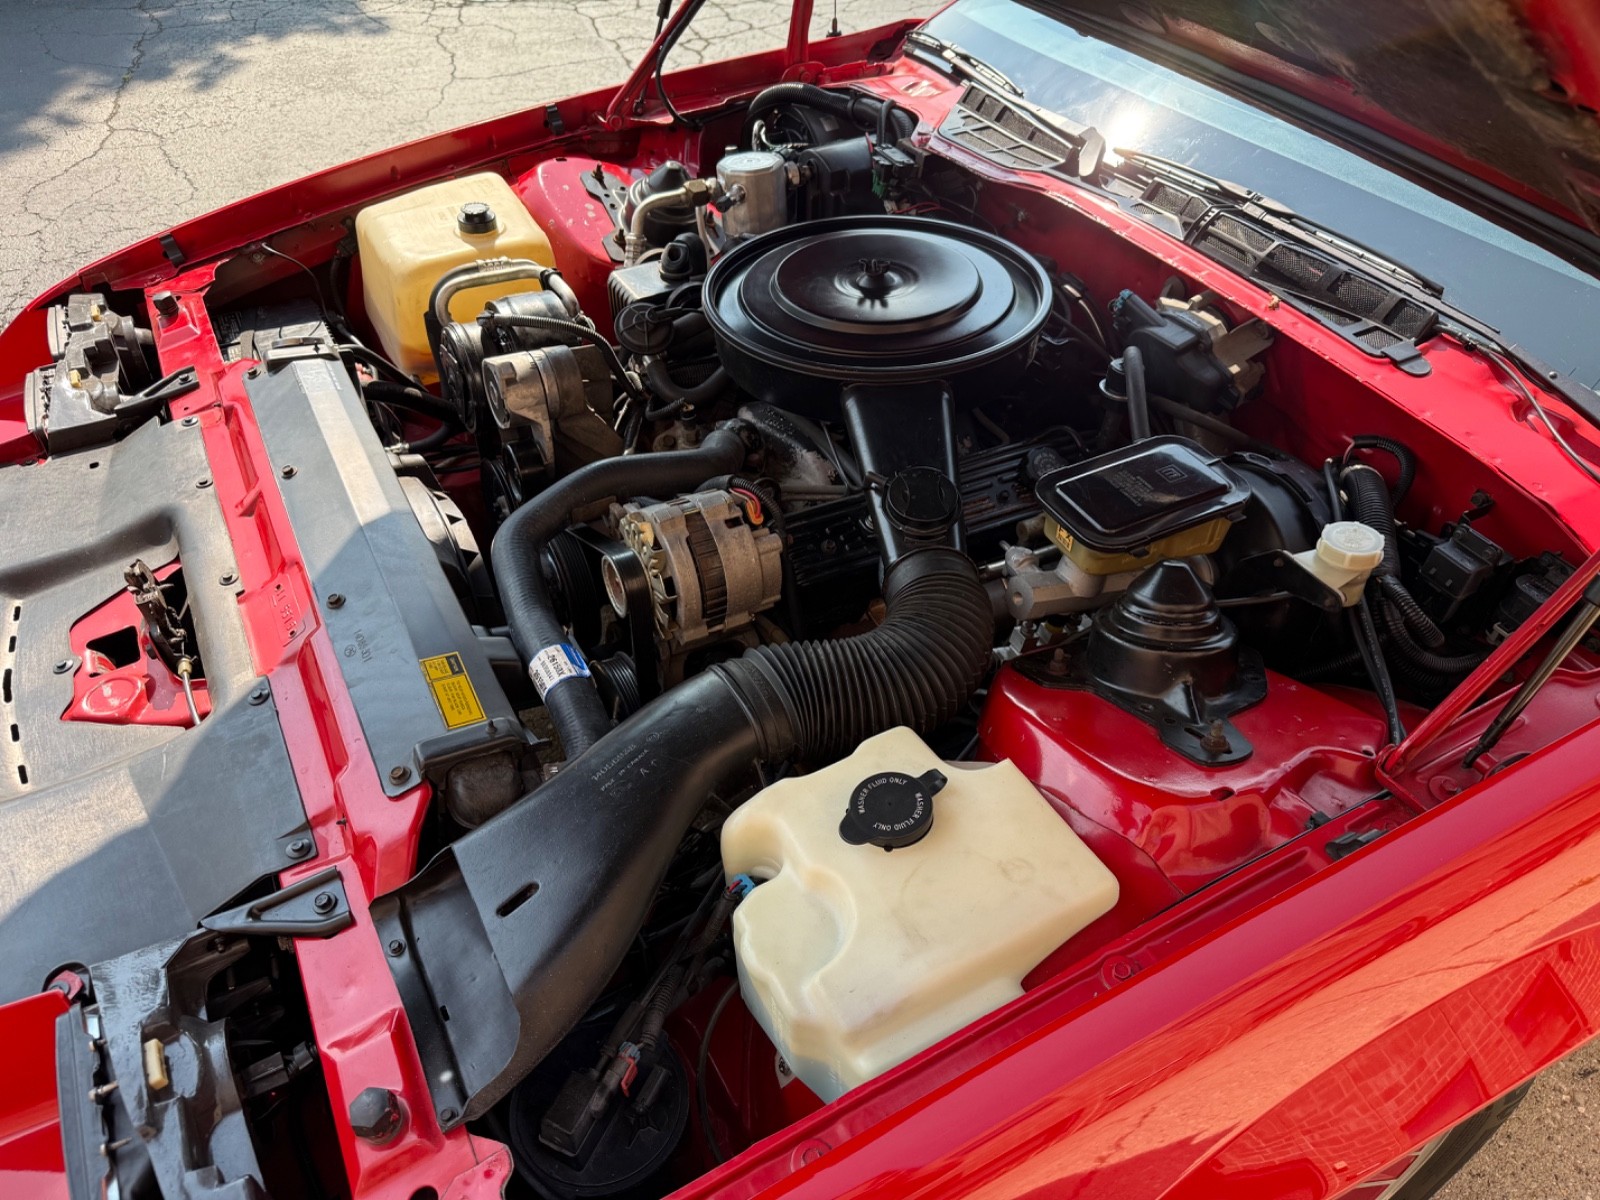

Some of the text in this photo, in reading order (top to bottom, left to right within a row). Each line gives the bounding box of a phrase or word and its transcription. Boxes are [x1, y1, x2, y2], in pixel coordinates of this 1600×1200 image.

[858, 776, 908, 815] WASHER FLUID ONLY
[872, 792, 924, 831] WASHER FLUID ONLY
